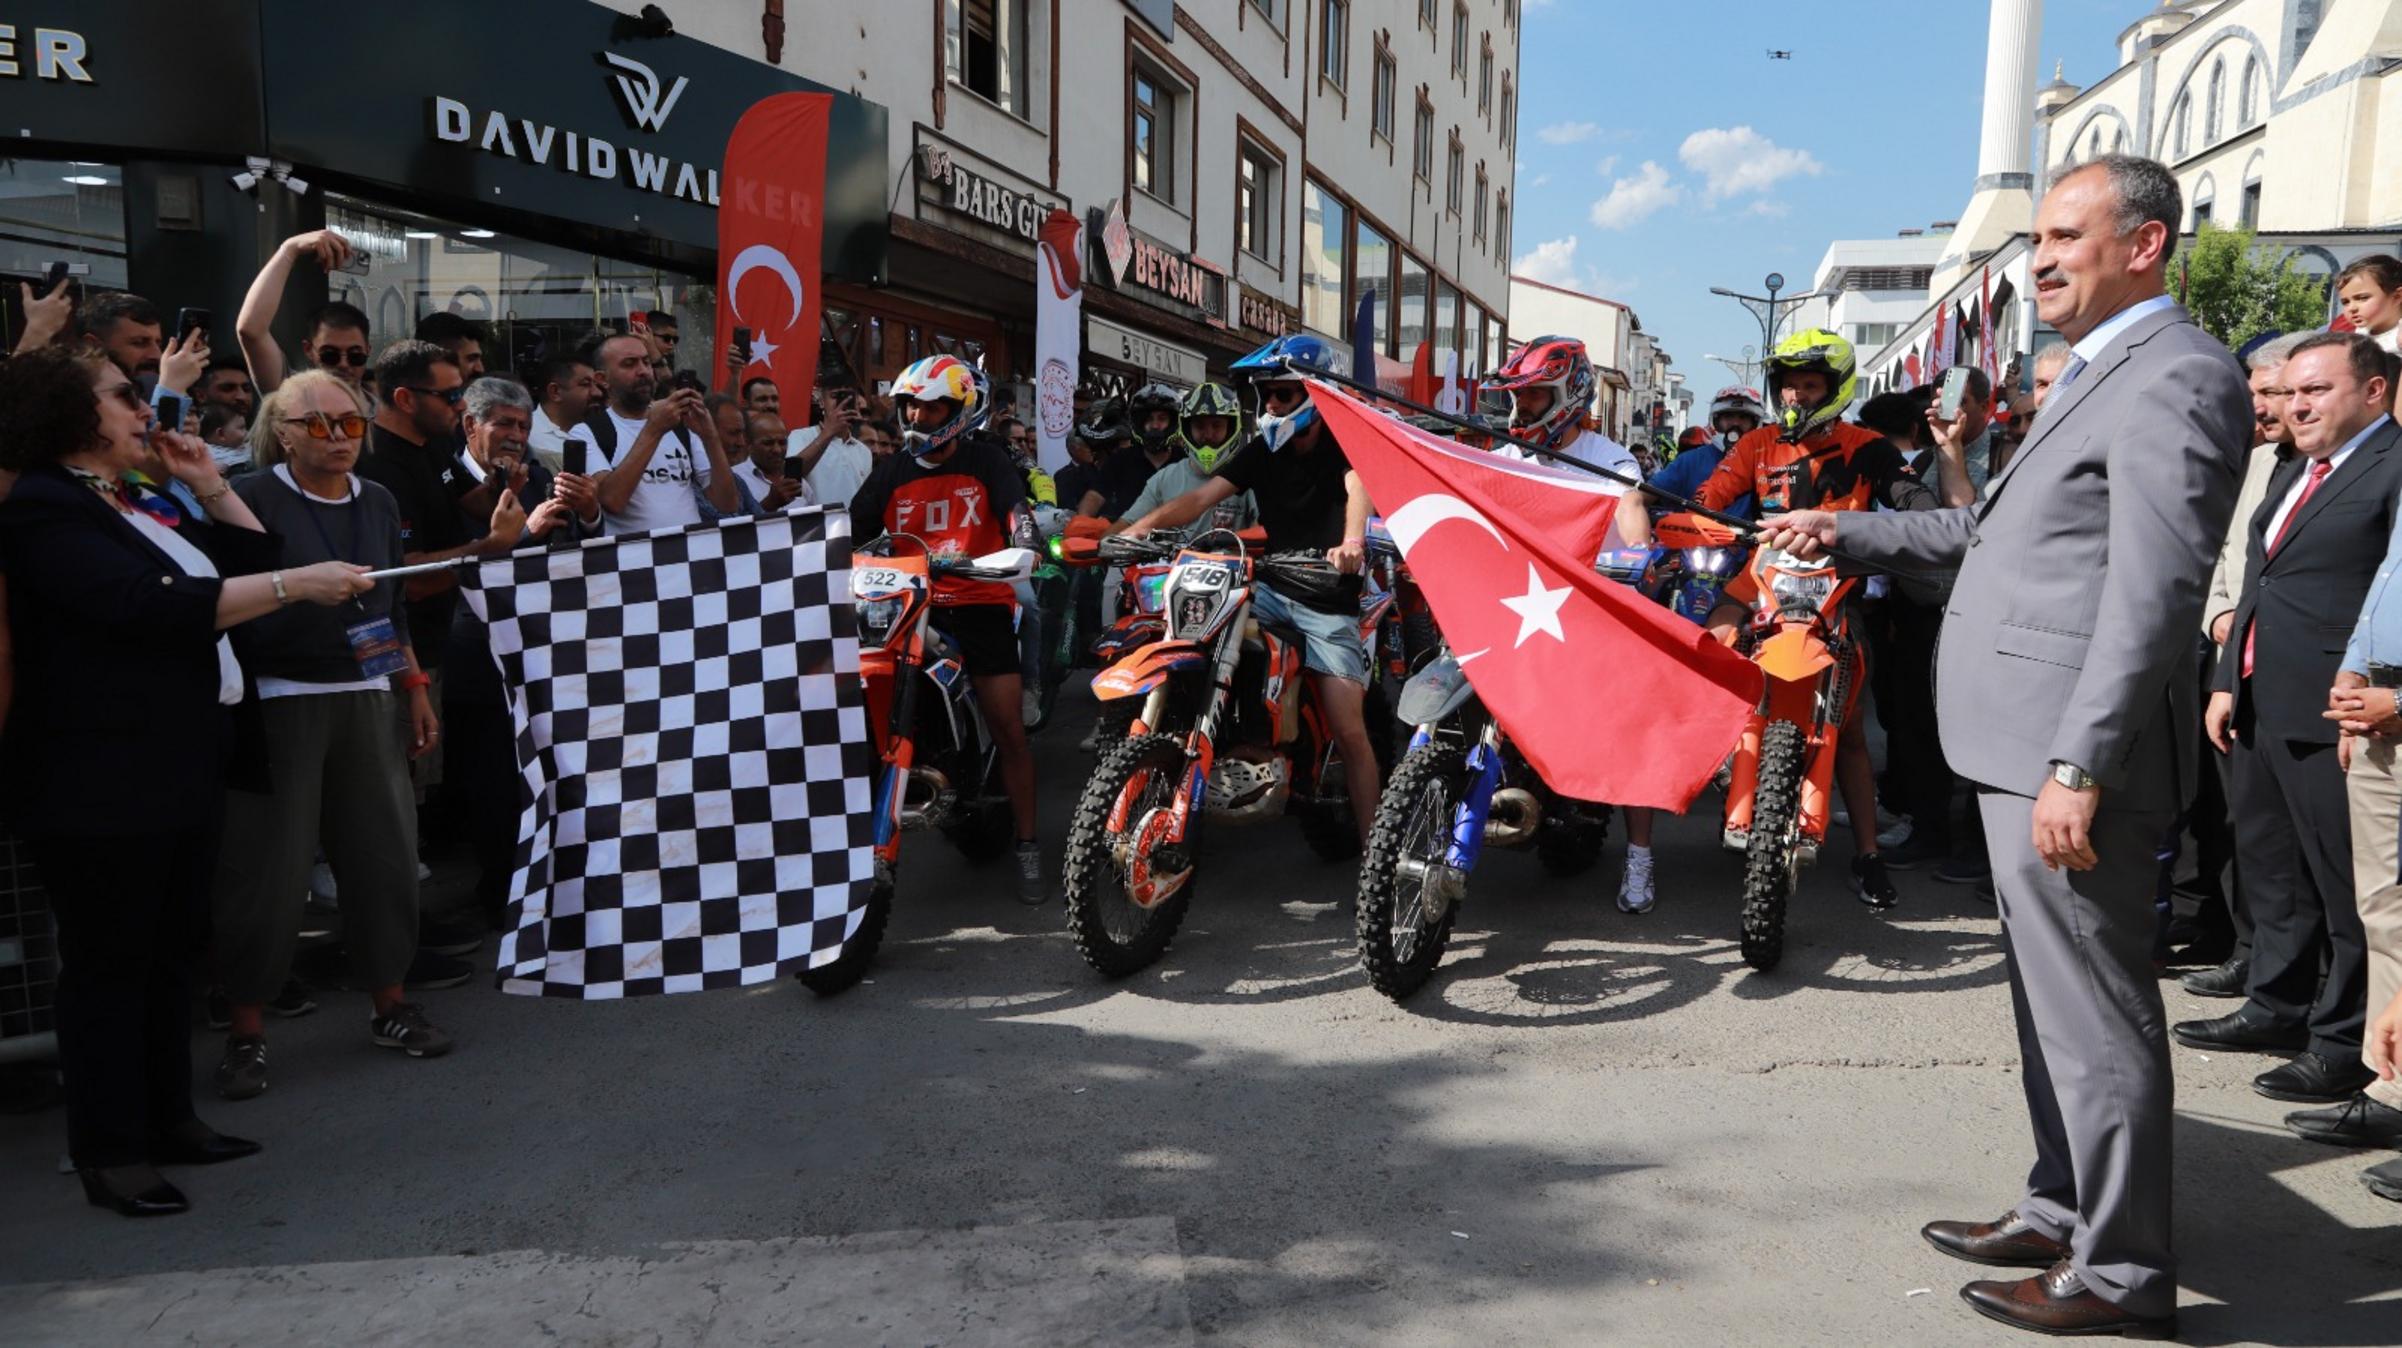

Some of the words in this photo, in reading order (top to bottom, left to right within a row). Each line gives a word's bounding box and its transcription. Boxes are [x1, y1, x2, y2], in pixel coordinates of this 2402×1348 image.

[954, 167, 1013, 230] BARS
[1134, 238, 1205, 308] BEYSAN
[895, 495, 982, 534] FOX
[863, 571, 897, 587] 522
